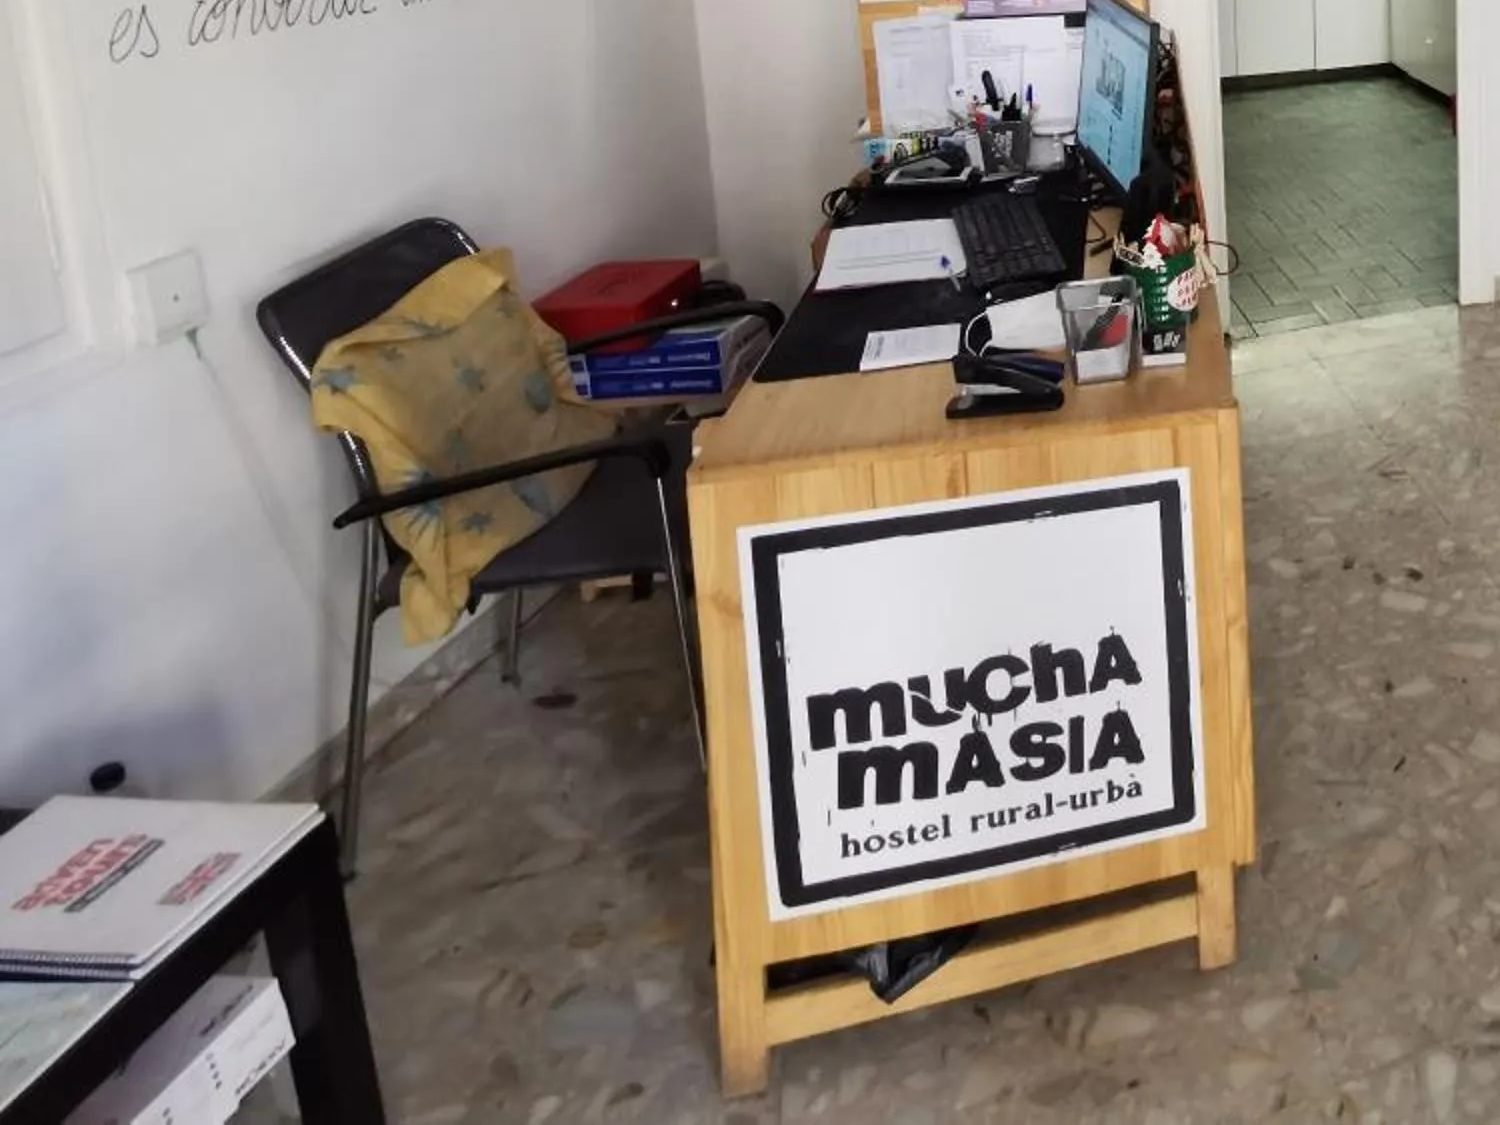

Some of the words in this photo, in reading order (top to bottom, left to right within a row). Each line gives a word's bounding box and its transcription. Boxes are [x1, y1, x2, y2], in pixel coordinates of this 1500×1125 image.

[107, 2, 160, 63] es
[840, 812, 953, 860] hostel
[970, 773, 1144, 834] rural-urbà
